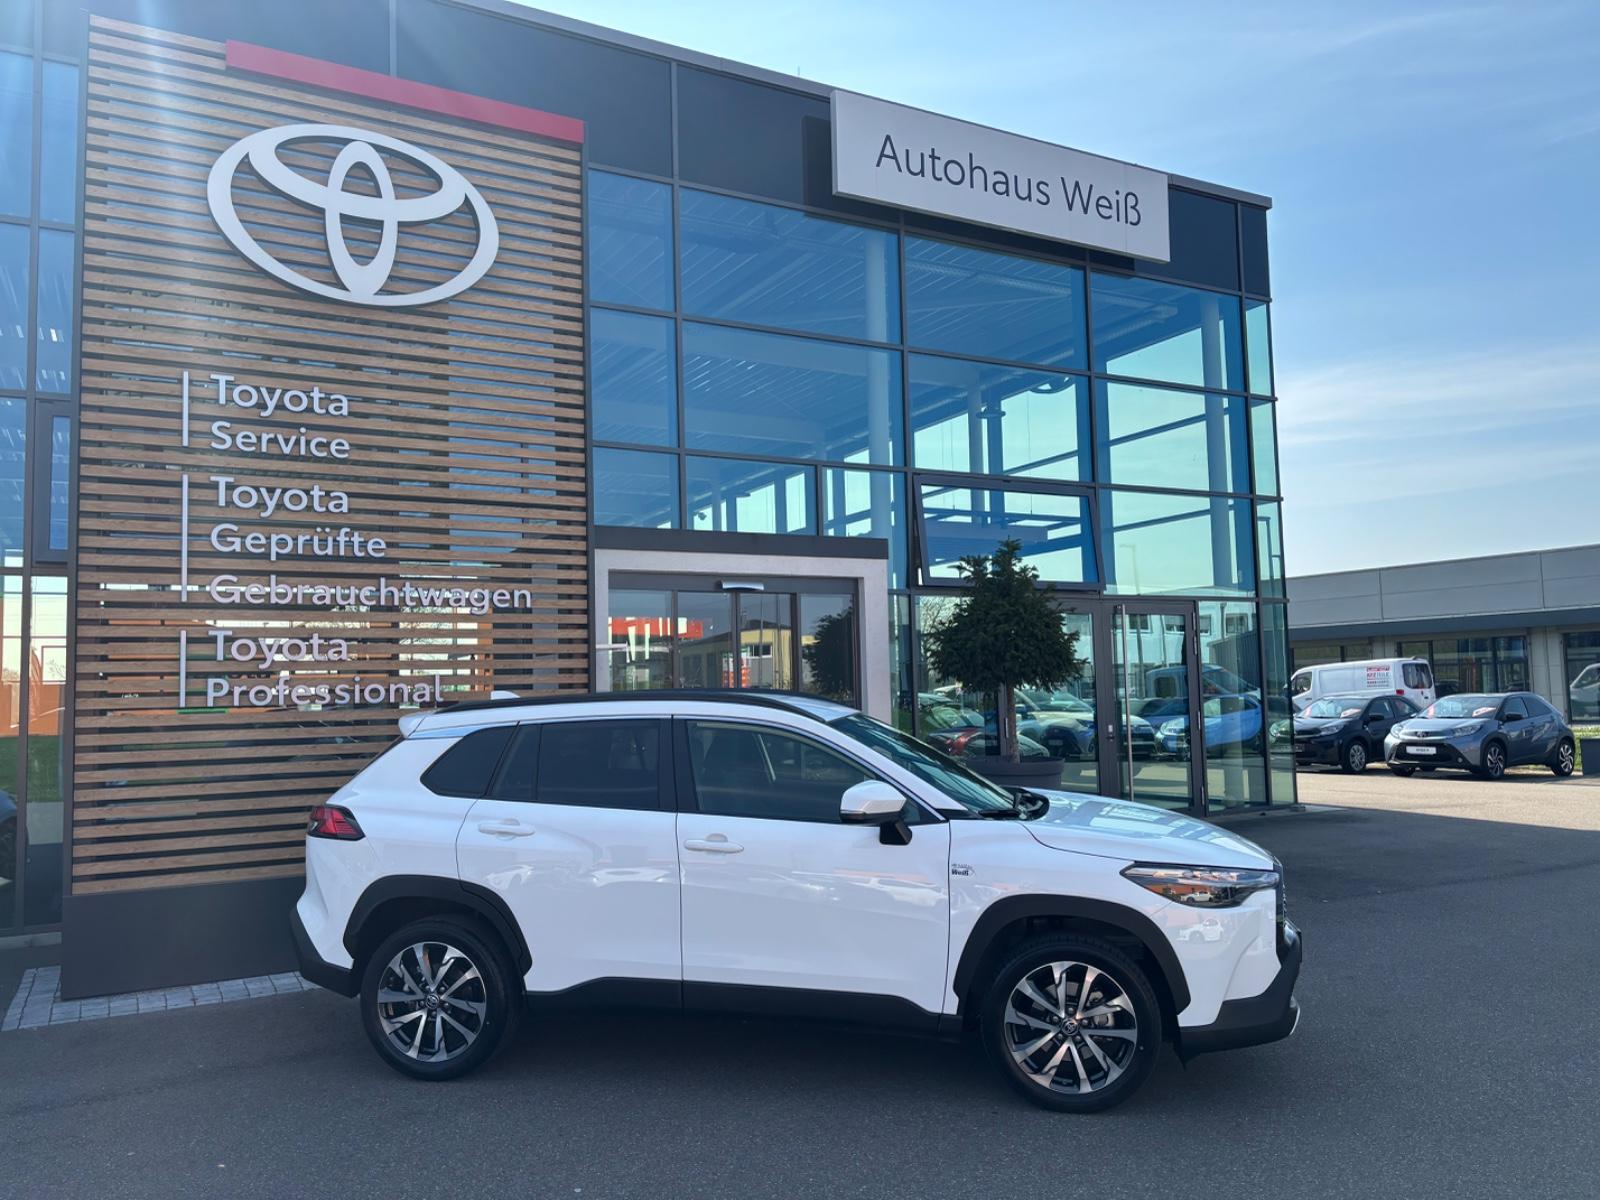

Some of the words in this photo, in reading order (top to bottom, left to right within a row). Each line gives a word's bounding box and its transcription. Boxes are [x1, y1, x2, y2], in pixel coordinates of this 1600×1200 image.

[875, 134, 1051, 206] Autohaus
[1060, 176, 1142, 226] Weiß
[209, 373, 349, 417] Toyota
[209, 420, 350, 459] Service
[209, 475, 349, 518] Toyota
[210, 523, 387, 561] Geprüfte
[209, 574, 532, 615] Gebrauchtwagen
[208, 630, 349, 669] Toyota
[206, 673, 444, 707] Professional
